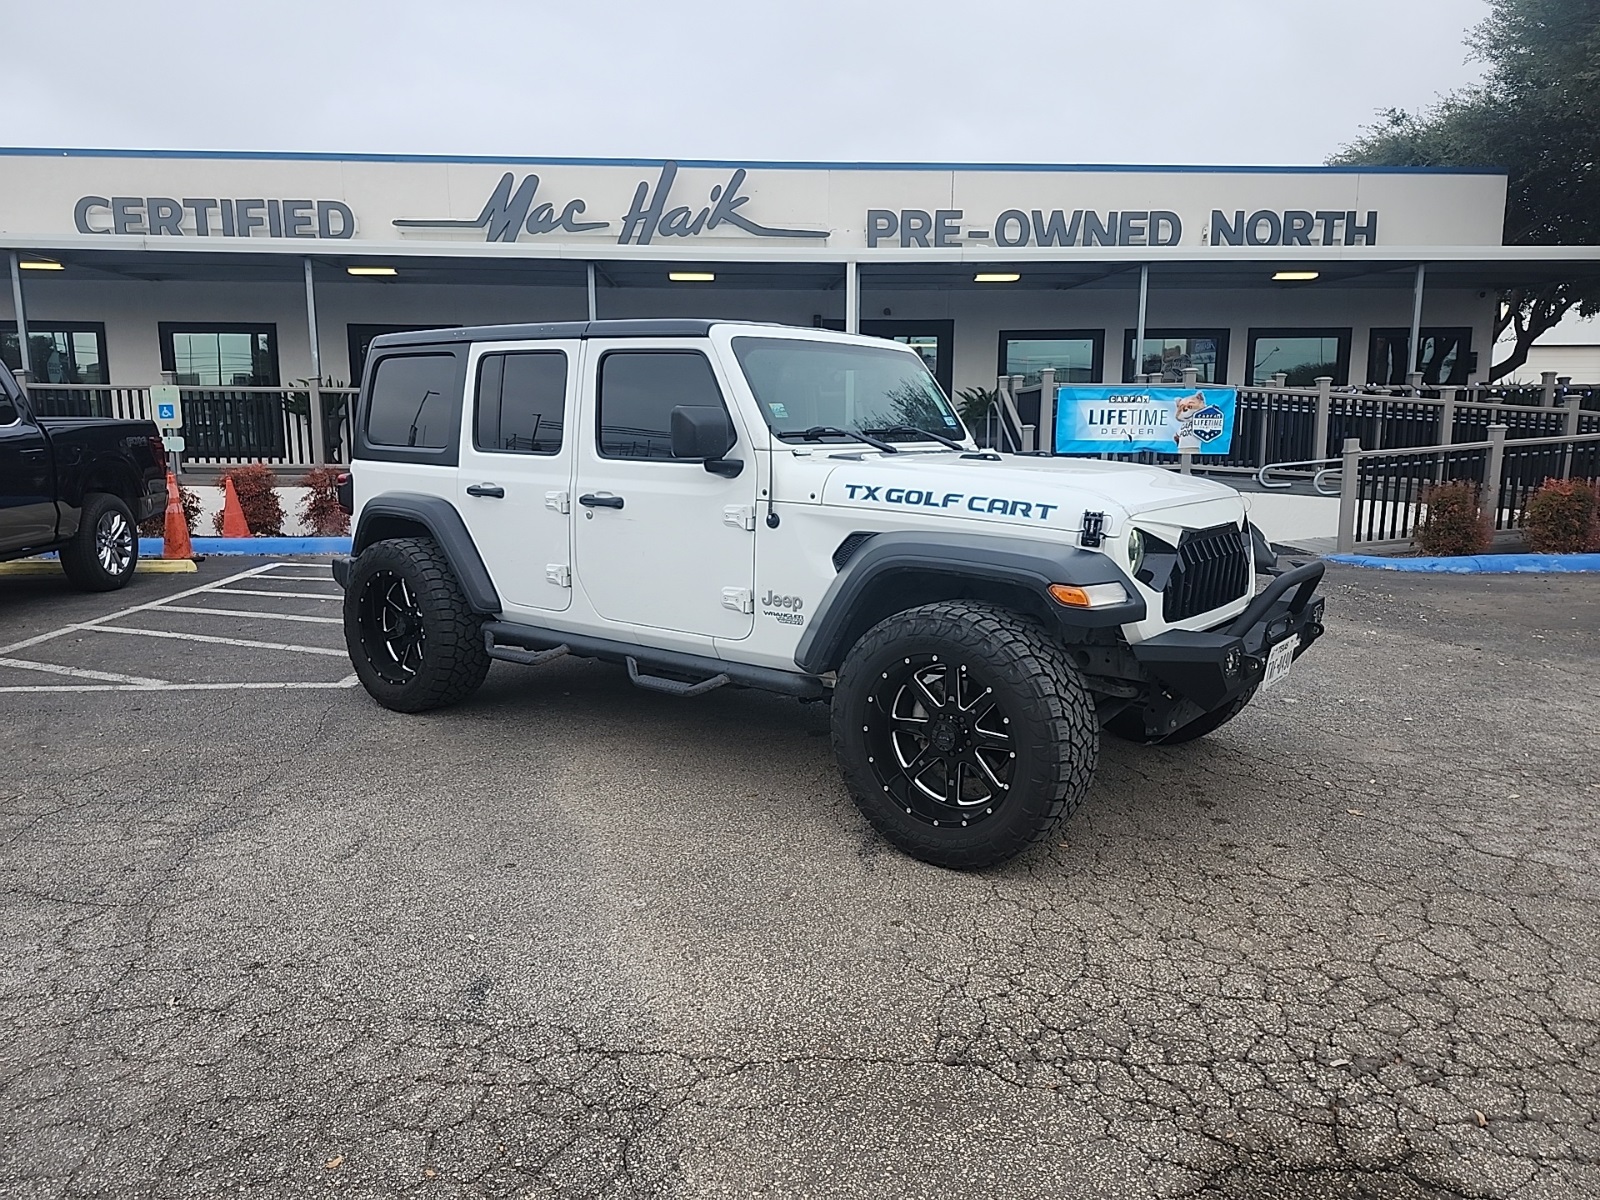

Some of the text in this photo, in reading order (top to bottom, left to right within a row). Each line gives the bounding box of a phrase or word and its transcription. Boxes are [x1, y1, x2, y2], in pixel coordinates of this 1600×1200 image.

[393, 160, 830, 245] Mac Haik
[73, 195, 356, 240] CERTIFIED
[866, 209, 1378, 247] PRE-OWNED NORTH
[1109, 395, 1150, 404] CARFAX
[1088, 409, 1169, 426] LIFETIME
[1193, 419, 1223, 427] LIFETIME
[845, 484, 1059, 520] TX GOLF CART
[761, 590, 803, 613] Jeep
[763, 610, 804, 620] WRANGLER
